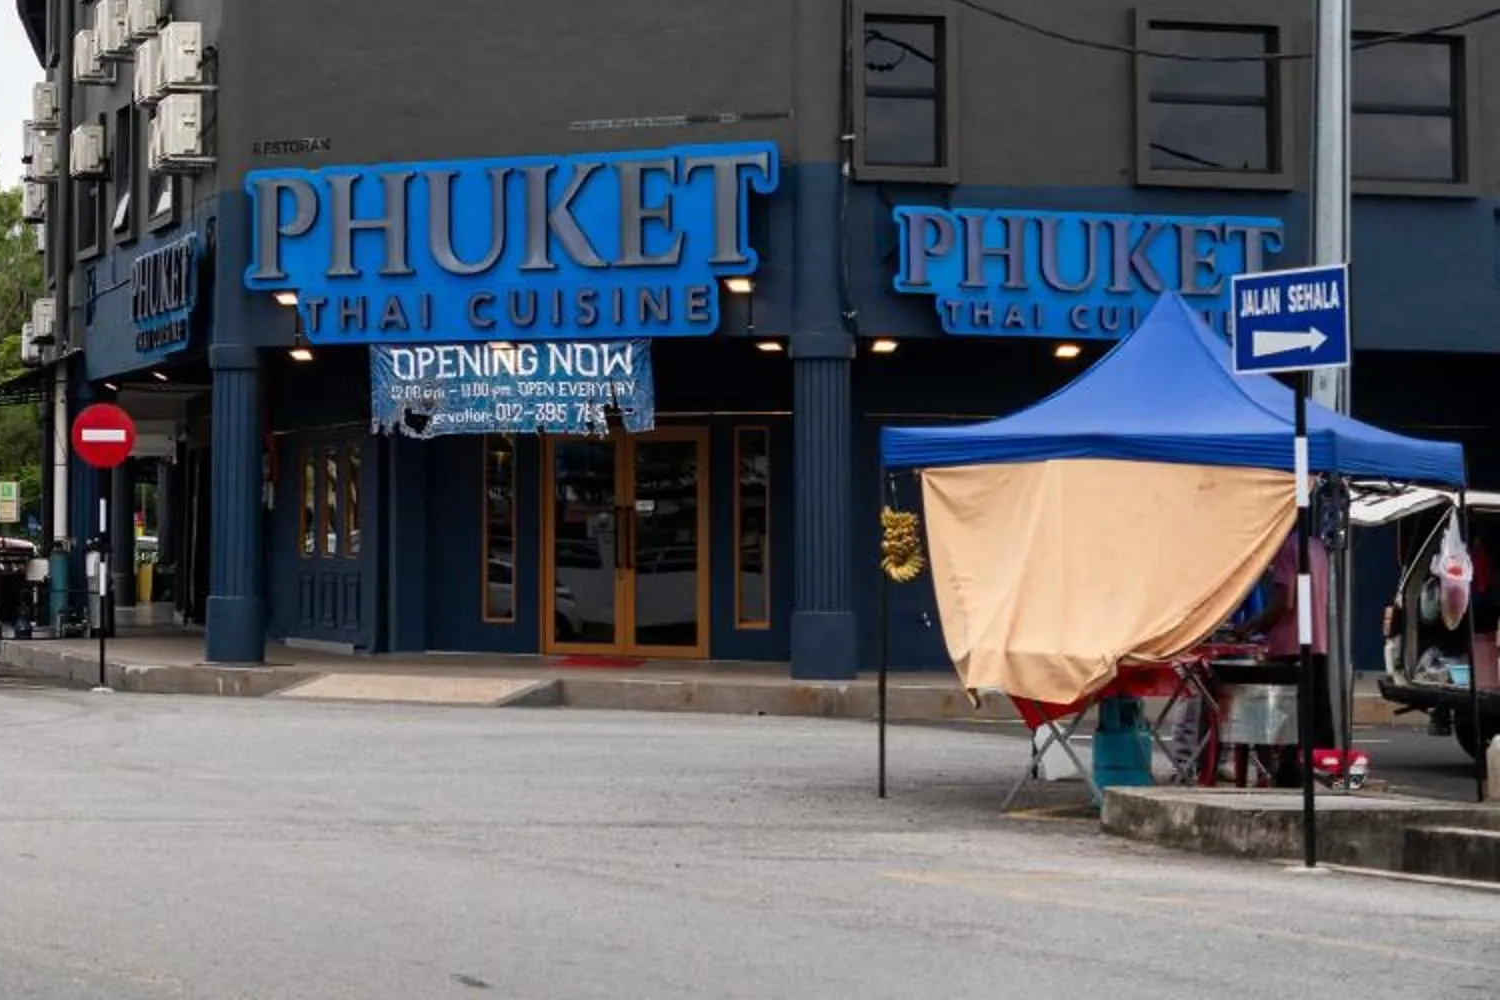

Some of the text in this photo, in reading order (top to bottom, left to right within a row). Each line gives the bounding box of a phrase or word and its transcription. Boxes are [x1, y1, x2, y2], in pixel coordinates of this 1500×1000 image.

[252, 151, 771, 280] PHUKET
[901, 212, 1285, 296] PHUKET
[132, 241, 192, 319] PHUKET
[1241, 280, 1340, 318] JALAN SEHALA
[306, 286, 712, 332] THAI CUISINE
[945, 299, 1043, 330] THAI
[390, 342, 633, 380] OPENING NOW
[516, 381, 555, 397] OPEN
